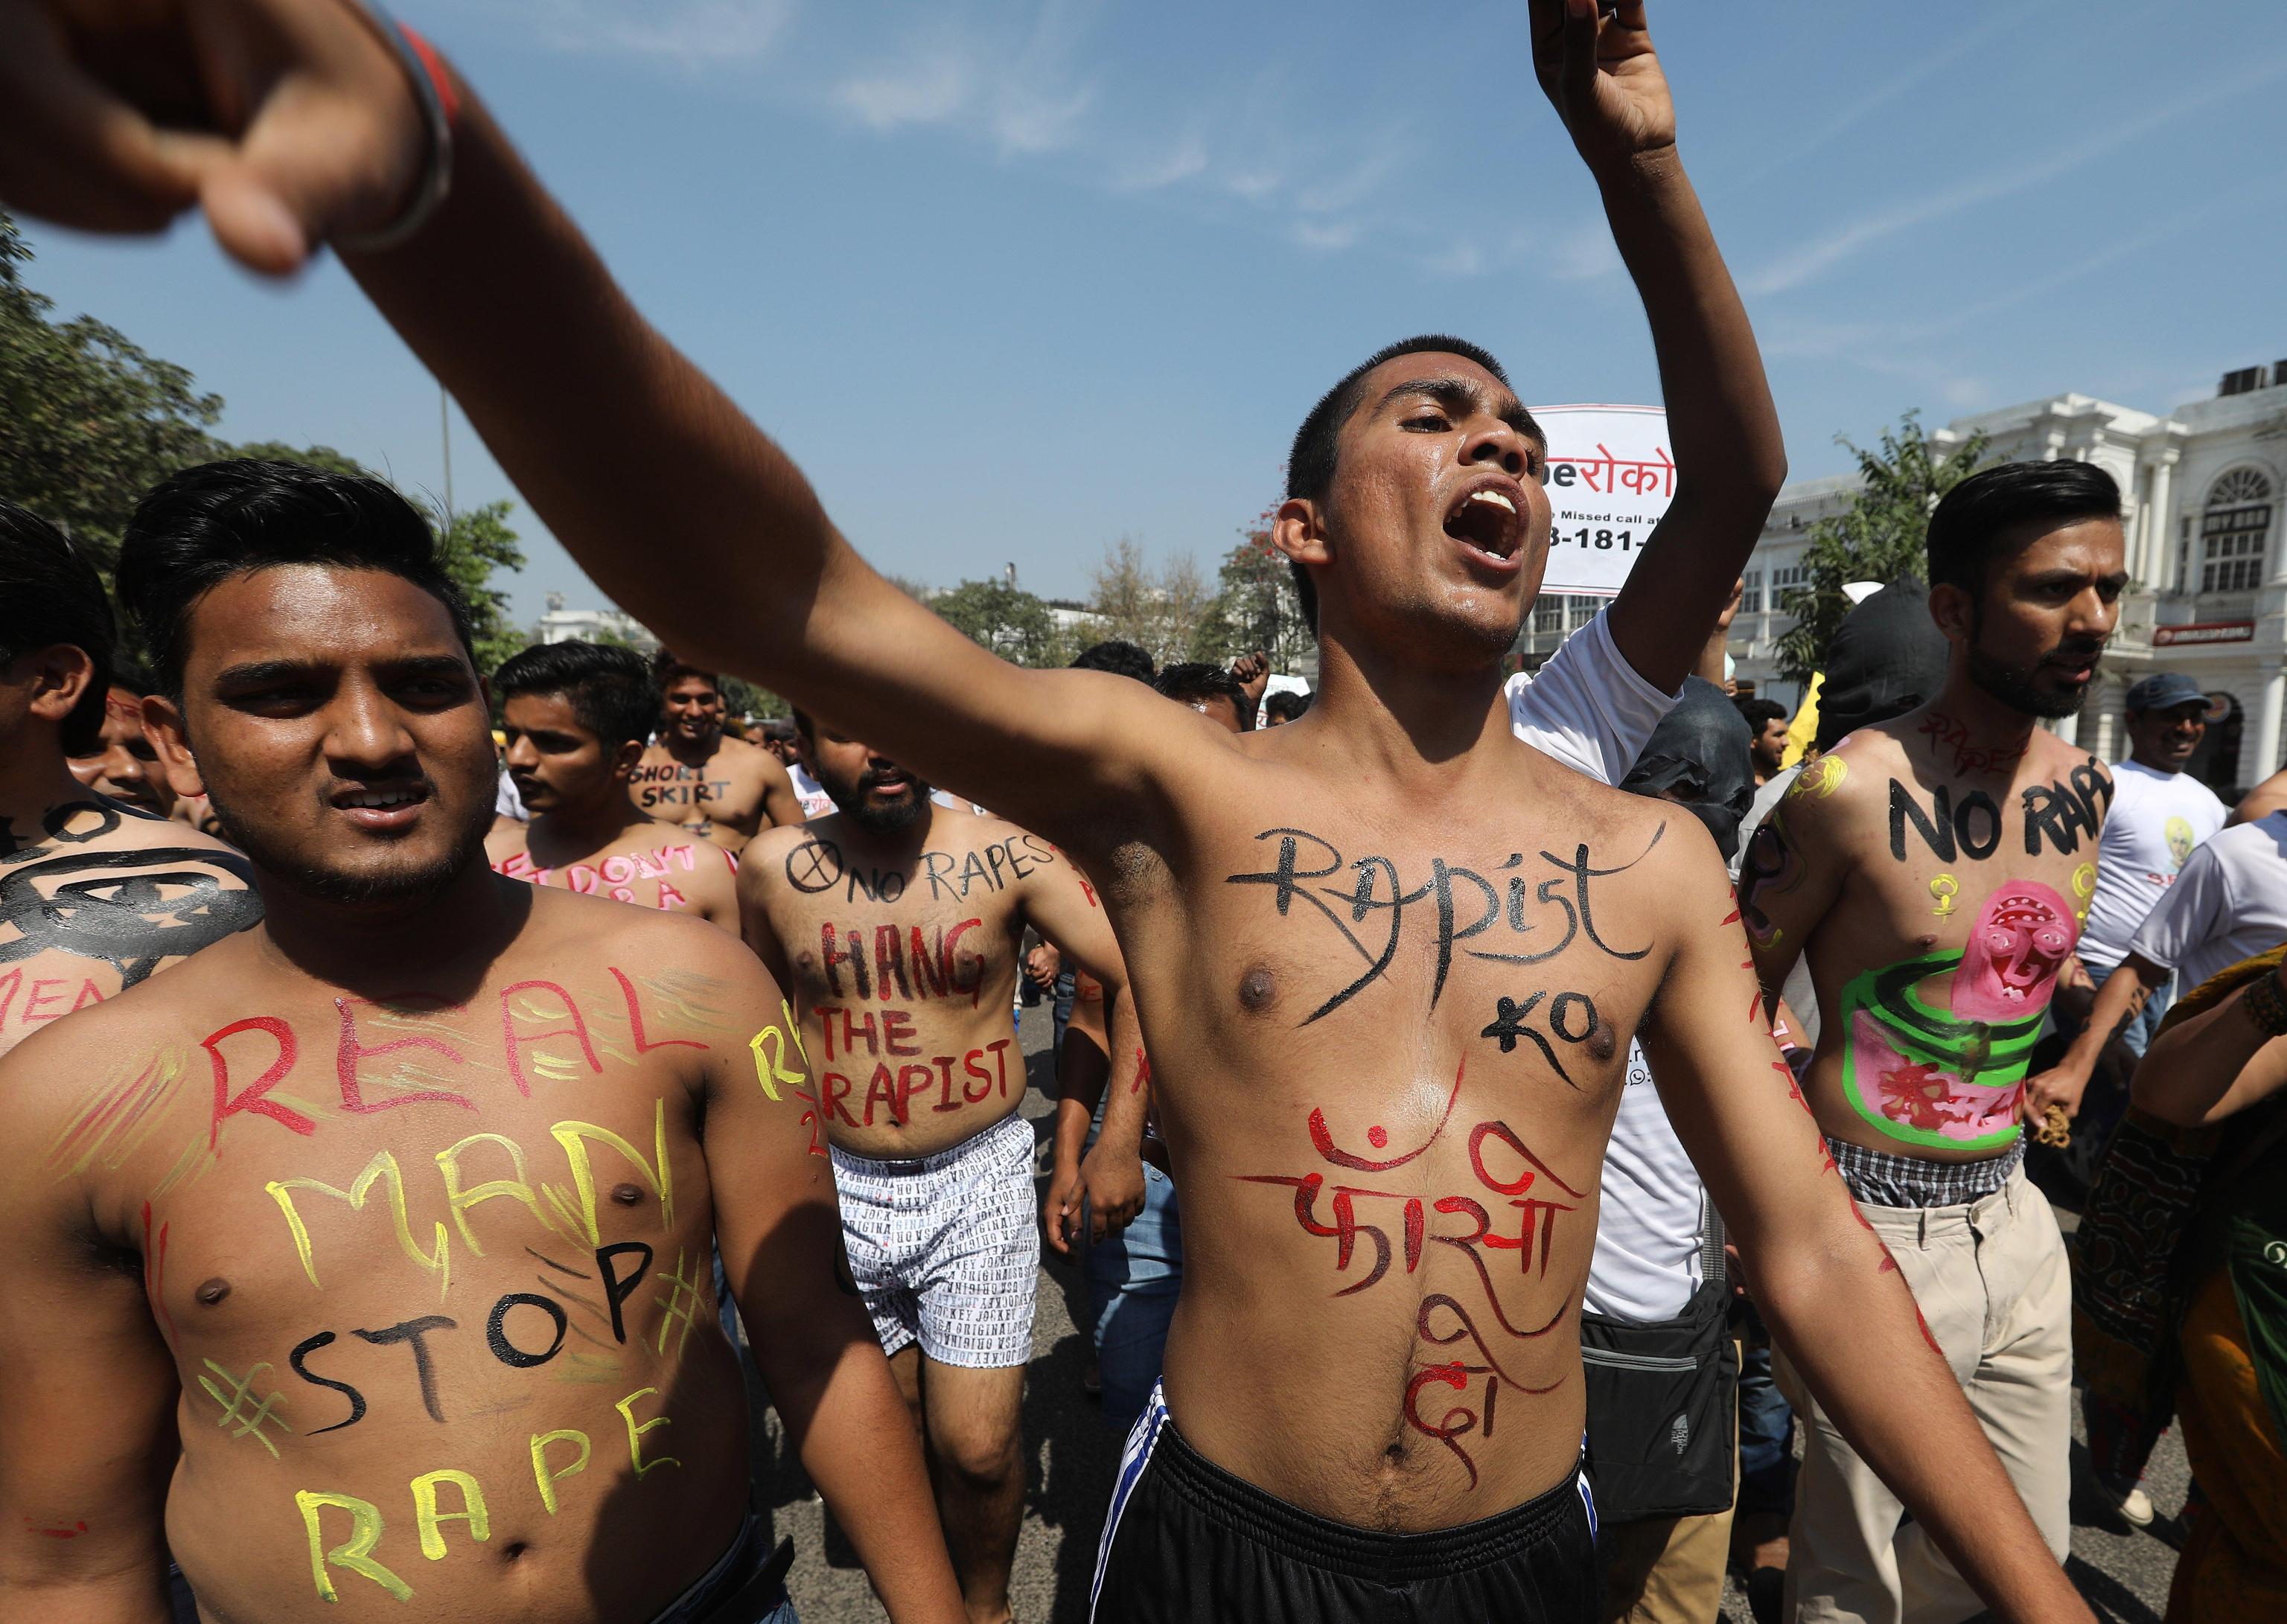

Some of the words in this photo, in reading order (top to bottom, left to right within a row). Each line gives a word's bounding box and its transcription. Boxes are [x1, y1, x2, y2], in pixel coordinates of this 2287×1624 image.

[1561, 511, 1610, 522] Missed
[1616, 514, 1642, 524] call
[642, 781, 731, 808] SKIRT
[1889, 778, 2001, 863] NO
[847, 866, 905, 904] NO
[919, 834, 1054, 904] RAPES
[821, 918, 985, 1009] HANG
[200, 967, 709, 1152] REAL
[813, 1006, 922, 1063] THE
[822, 1038, 1011, 1128] RAPIST
[264, 1096, 674, 1301] MAN
[290, 1241, 654, 1436] STOP
[296, 1387, 680, 1604] RAPE
